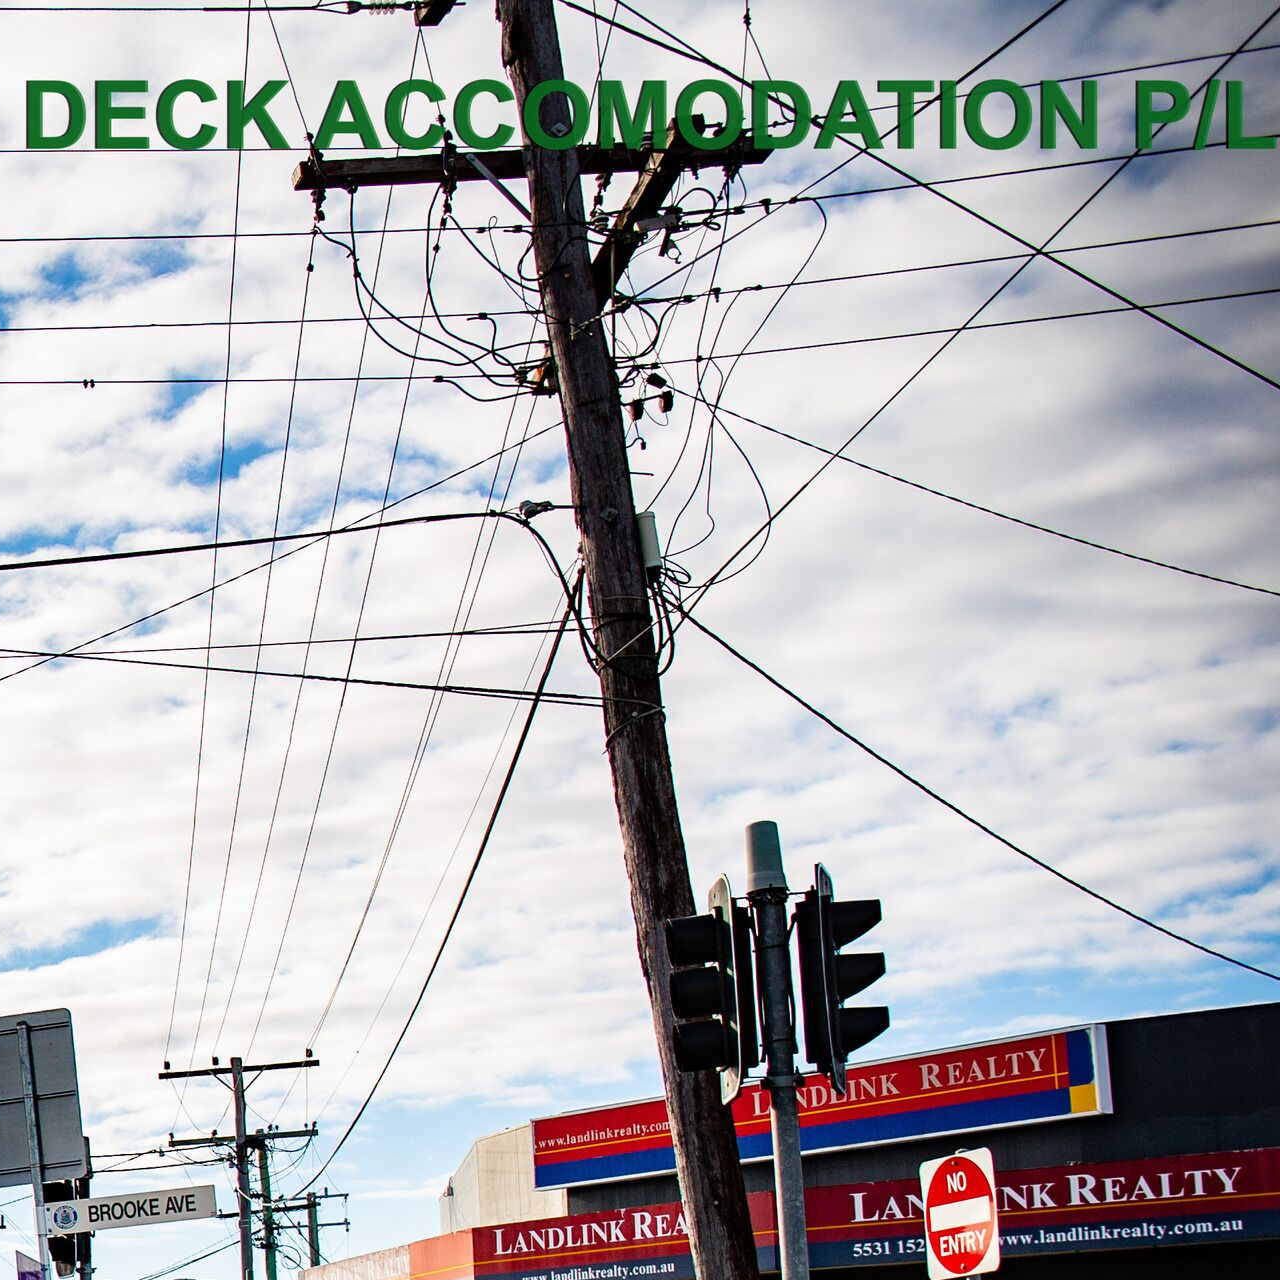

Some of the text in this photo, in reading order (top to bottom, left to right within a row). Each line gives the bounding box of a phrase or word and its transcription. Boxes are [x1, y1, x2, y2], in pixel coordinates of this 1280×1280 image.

[751, 1047, 1047, 1117] LNDLINK REALTY
[849, 1166, 1243, 1223] LANNK REALTY
[946, 1170, 967, 1194] NO
[87, 1197, 160, 1223] BROOKE
[165, 1194, 197, 1215] AVE
[492, 1210, 689, 1256] LANDLINK REA
[853, 1240, 891, 1257] 5531
[897, 1238, 926, 1254] 152
[939, 1228, 988, 1257] ENTRY
